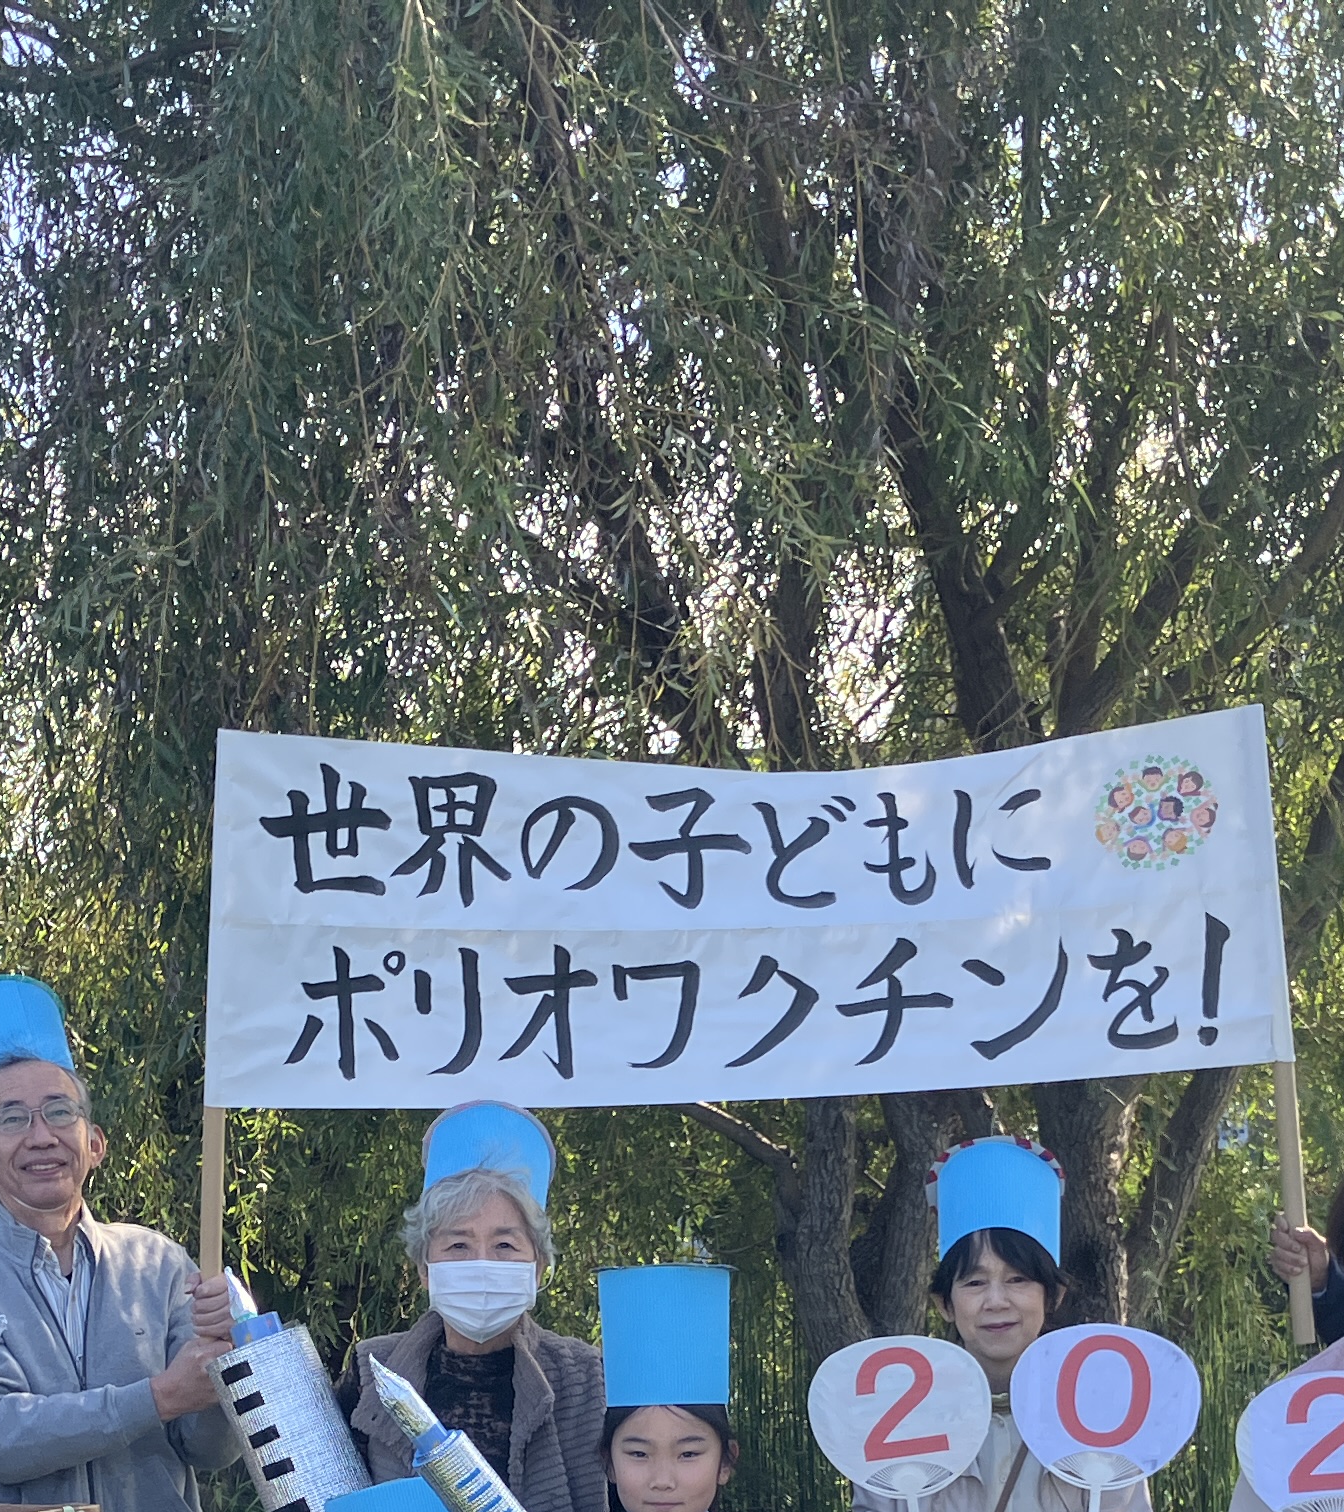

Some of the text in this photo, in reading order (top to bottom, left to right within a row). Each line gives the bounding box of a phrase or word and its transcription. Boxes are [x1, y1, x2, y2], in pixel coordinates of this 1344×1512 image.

[259, 763, 1052, 908] 世界の子どもに
[285, 912, 1231, 1080] ポリオワクチンを!
[856, 1346, 949, 1461] 2
[1057, 1335, 1151, 1447] 0
